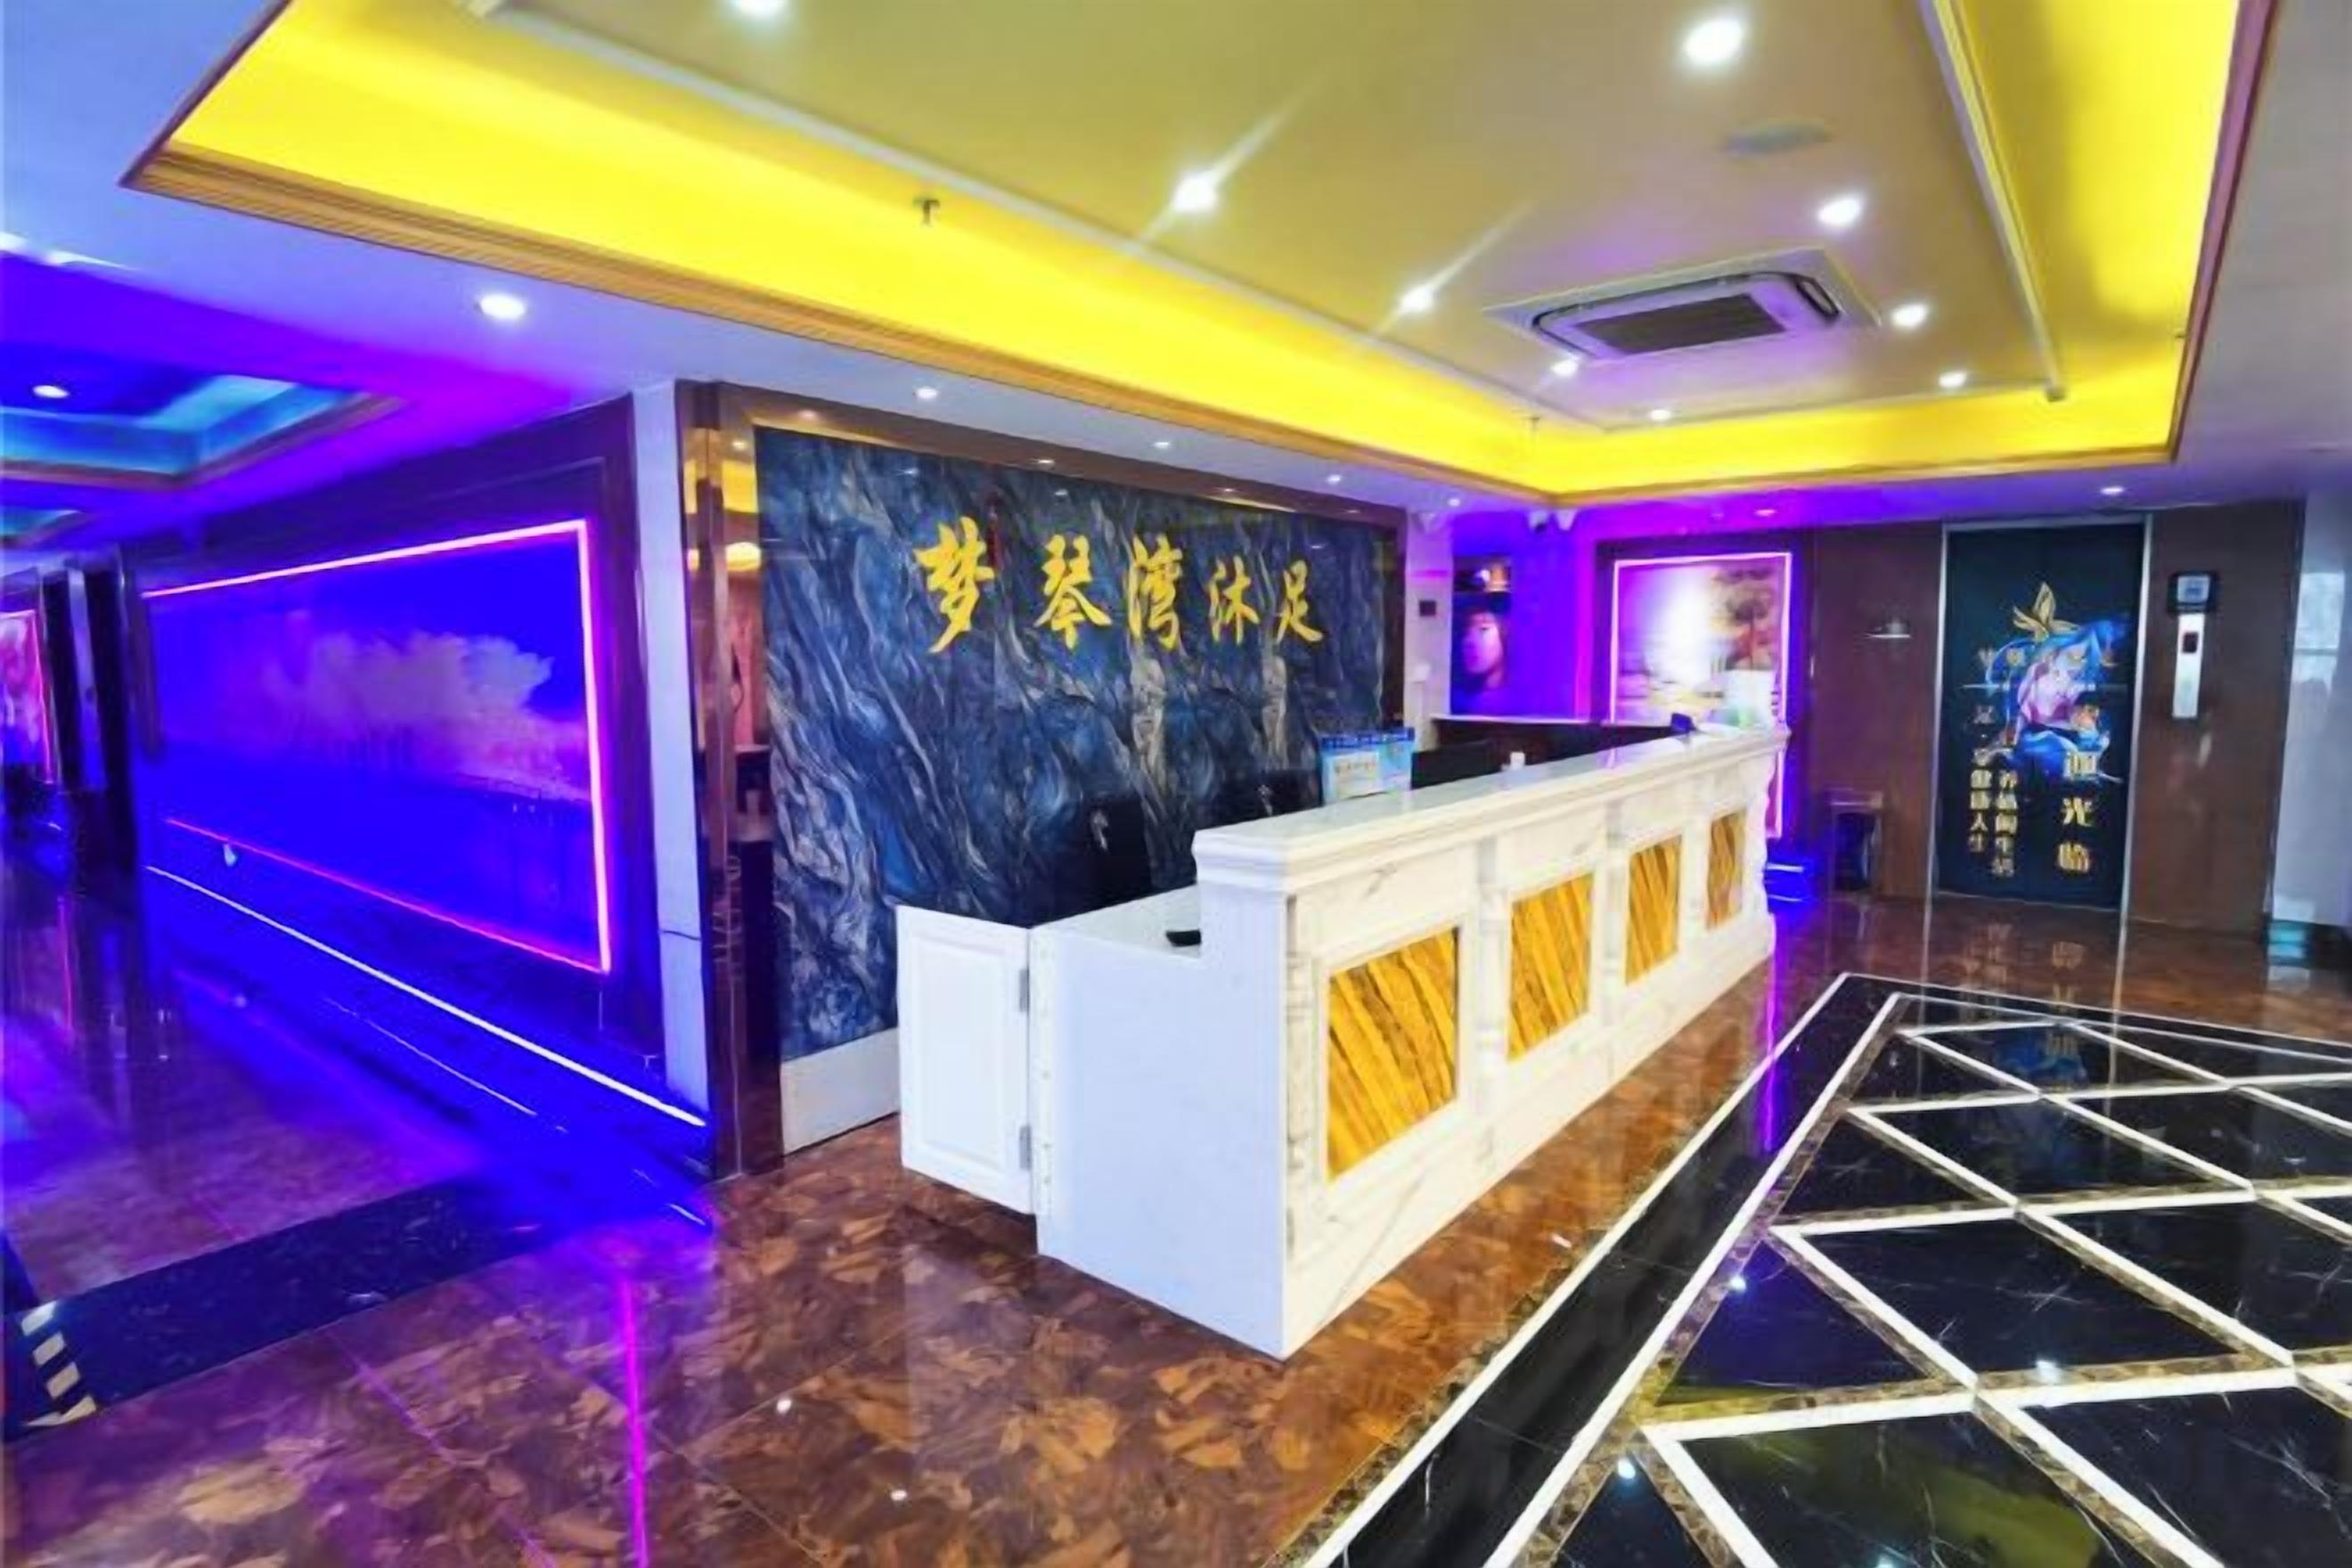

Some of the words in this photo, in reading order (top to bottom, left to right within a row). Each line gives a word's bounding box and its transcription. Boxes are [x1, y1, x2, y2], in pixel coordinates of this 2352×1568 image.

[912, 516, 1324, 653] 梦琴湾沐足
